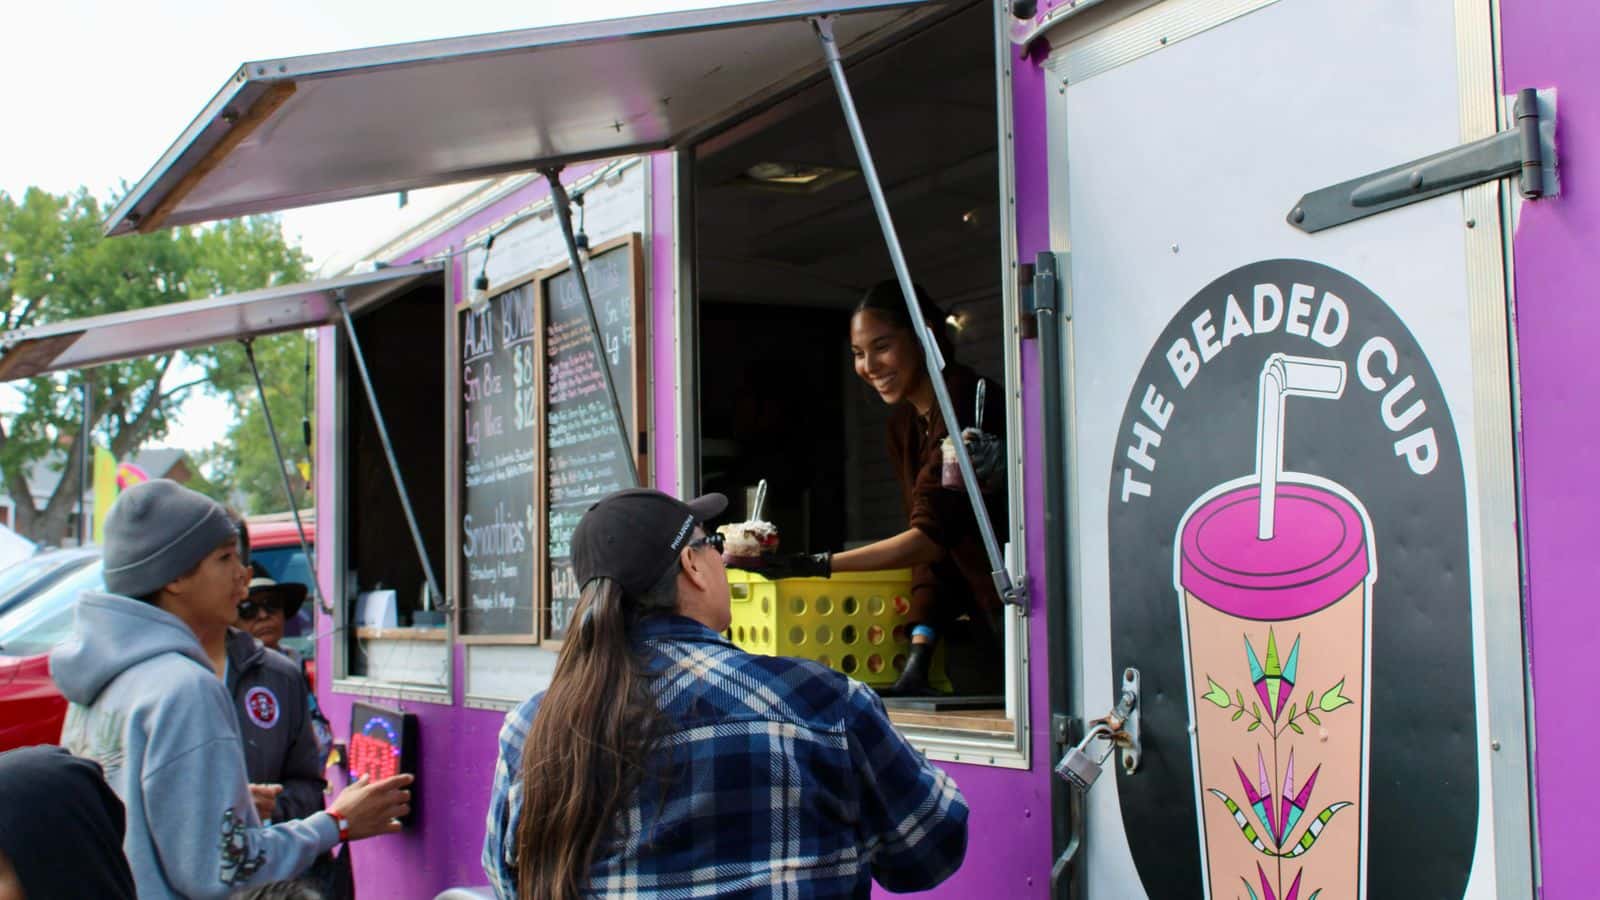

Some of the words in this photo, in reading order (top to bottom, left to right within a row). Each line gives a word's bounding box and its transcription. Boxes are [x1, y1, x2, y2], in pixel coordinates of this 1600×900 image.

[513, 344, 532, 388] $8
[606, 333, 618, 365] Lg
[1121, 384, 1175, 503] THE
[1166, 283, 1349, 389] BEADED
[1356, 336, 1439, 475] CUP
[463, 502, 525, 558] Smoothies
